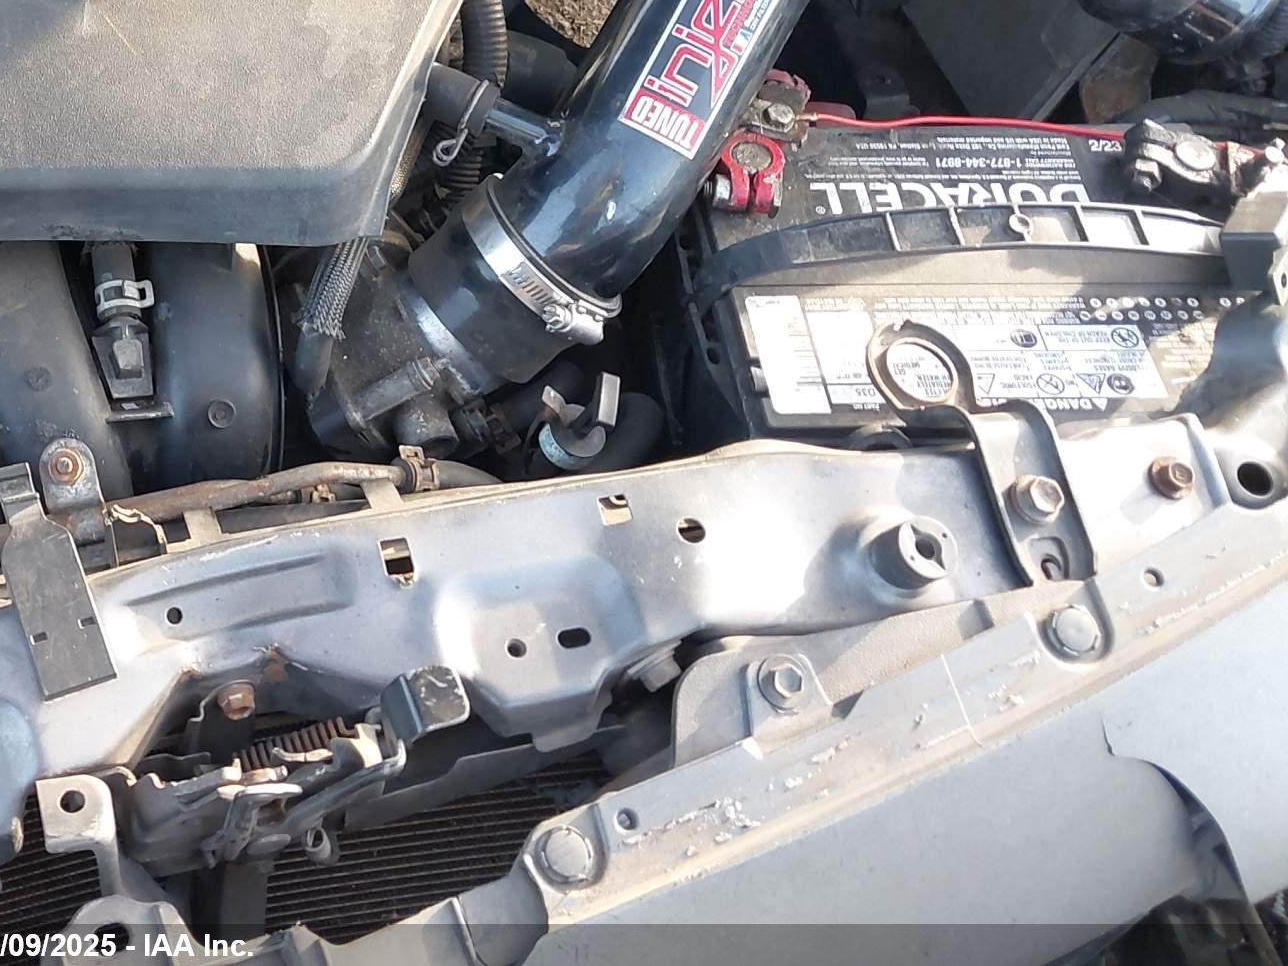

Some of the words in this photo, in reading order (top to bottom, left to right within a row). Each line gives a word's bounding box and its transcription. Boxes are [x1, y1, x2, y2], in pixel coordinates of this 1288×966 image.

[631, 95, 701, 150] TUNED
[1088, 138, 1123, 152] 2/23
[809, 182, 1090, 215] DURACELL
